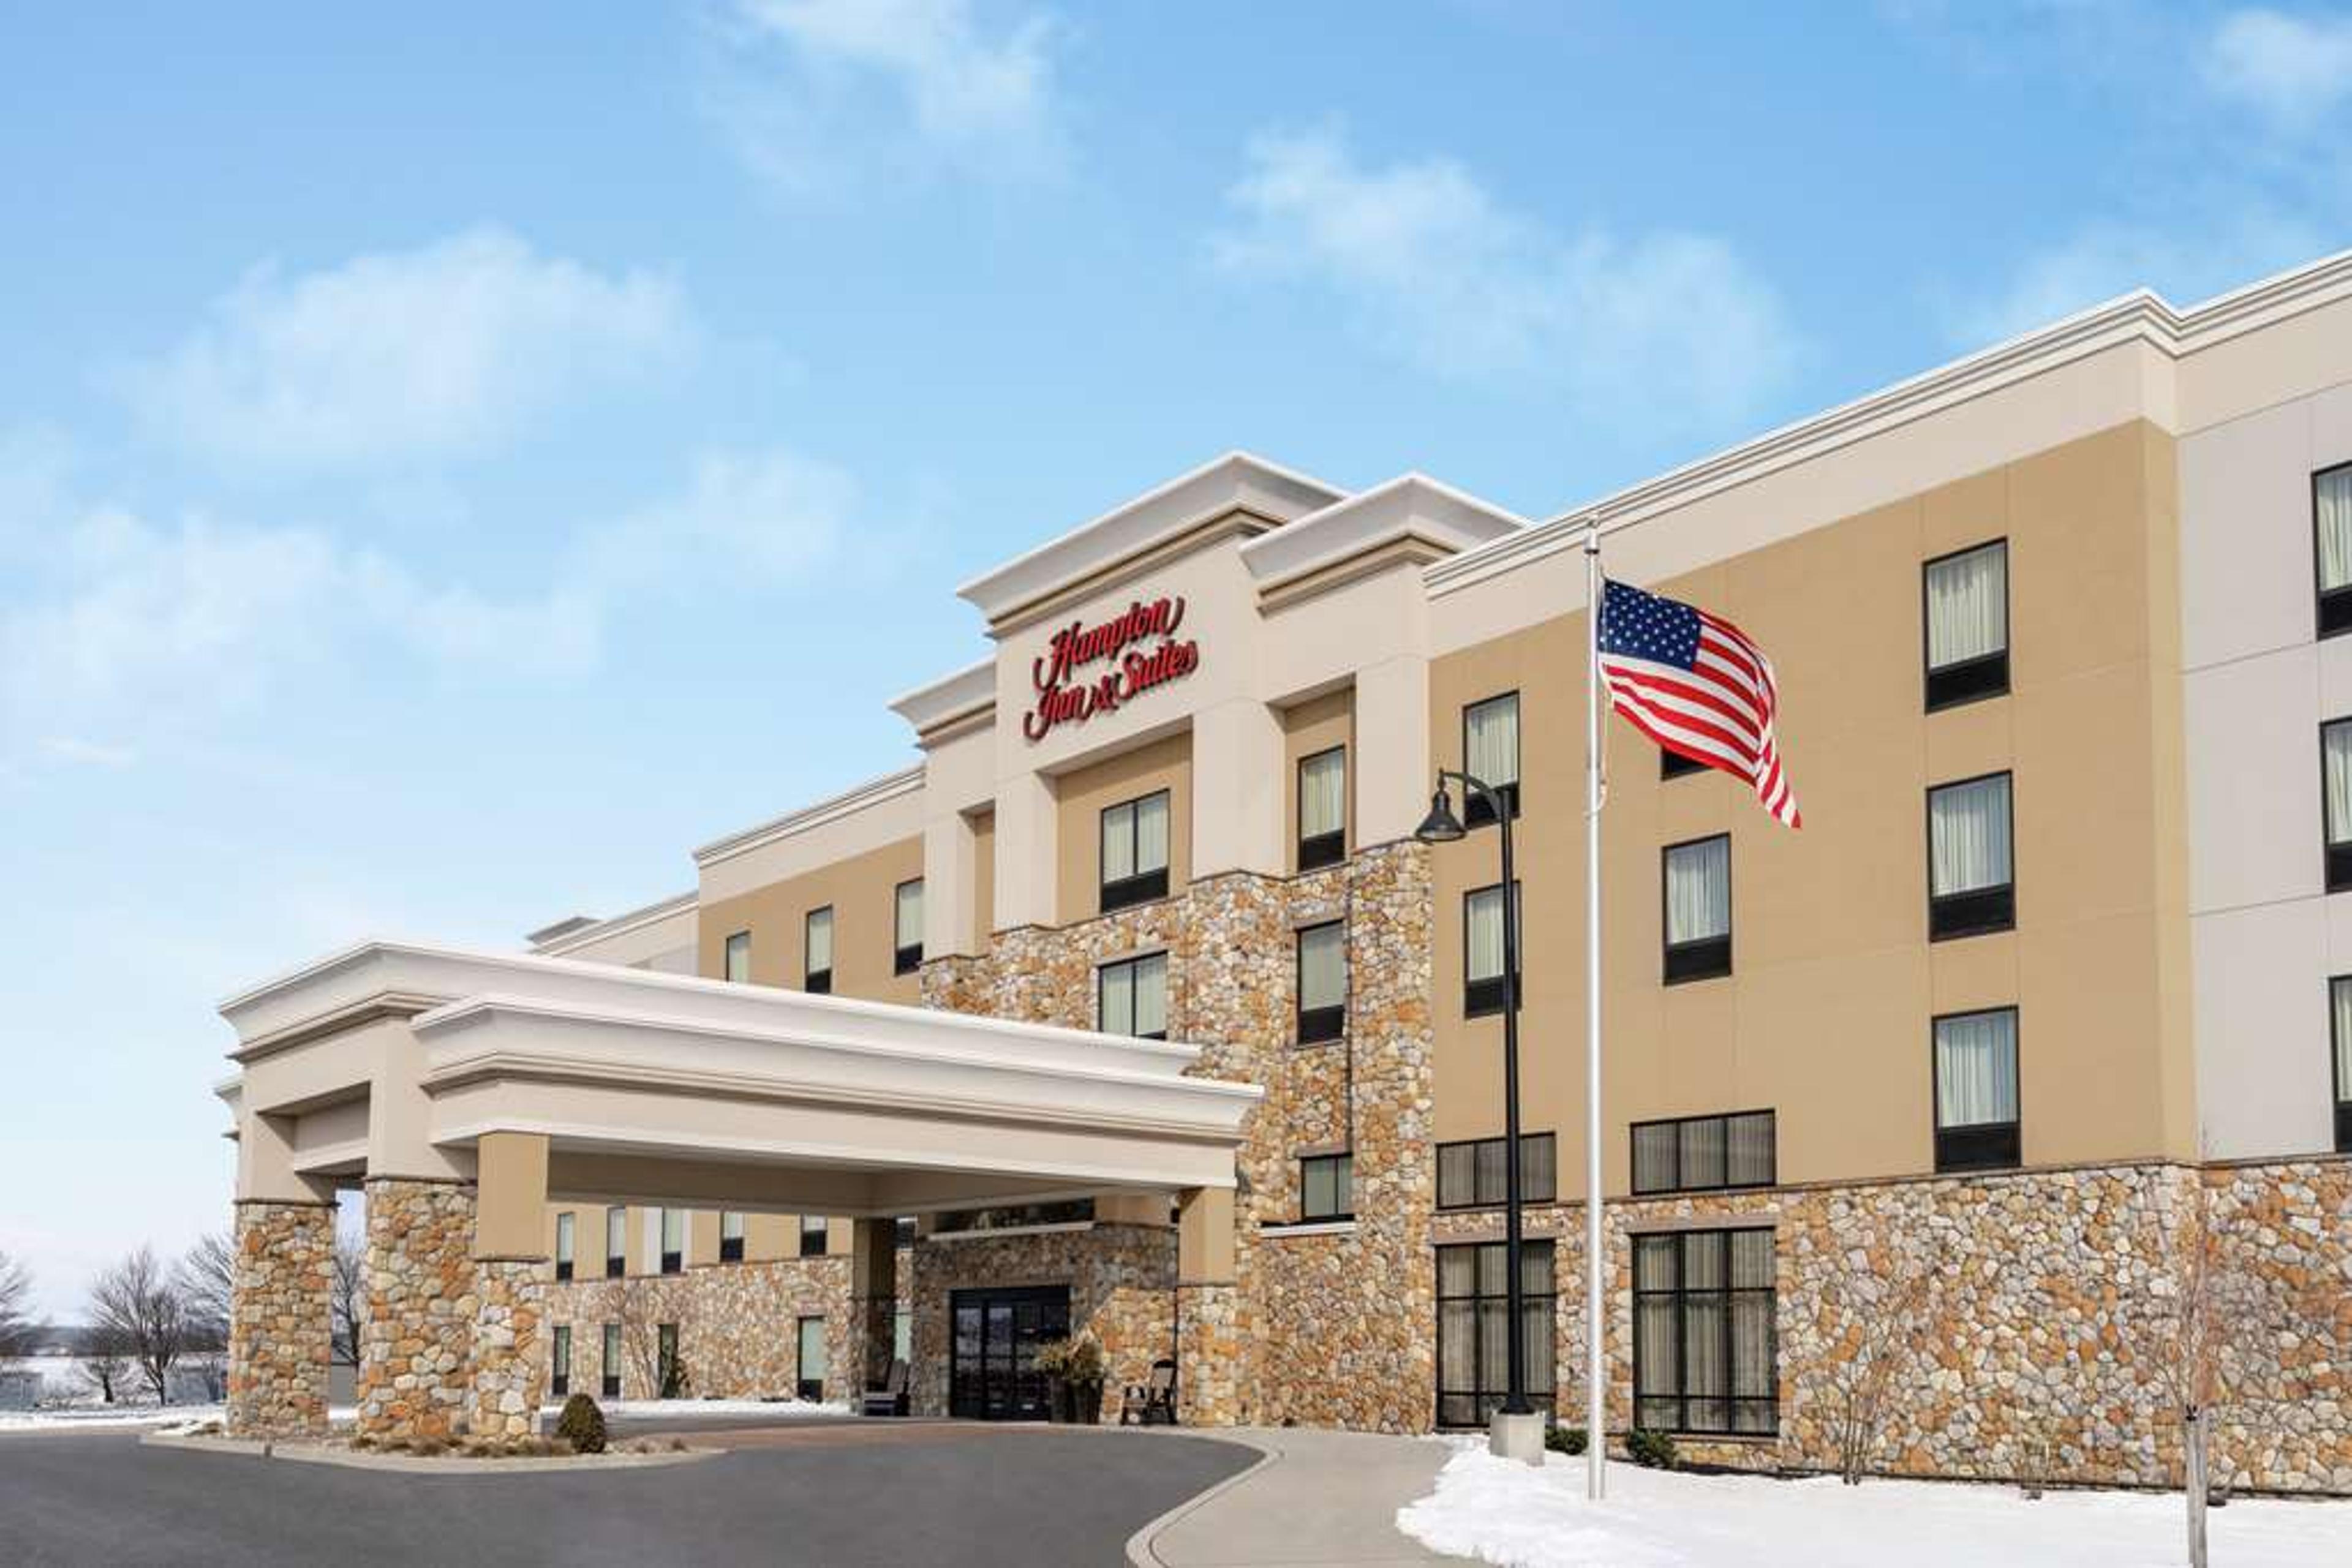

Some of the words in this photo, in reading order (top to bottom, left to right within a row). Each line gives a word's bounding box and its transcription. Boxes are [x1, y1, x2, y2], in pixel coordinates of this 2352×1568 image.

[1023, 685, 1096, 742] Inn
[1093, 675, 1120, 712] &
[1114, 639, 1199, 700] Suites
[1033, 596, 1185, 692] Hampton
